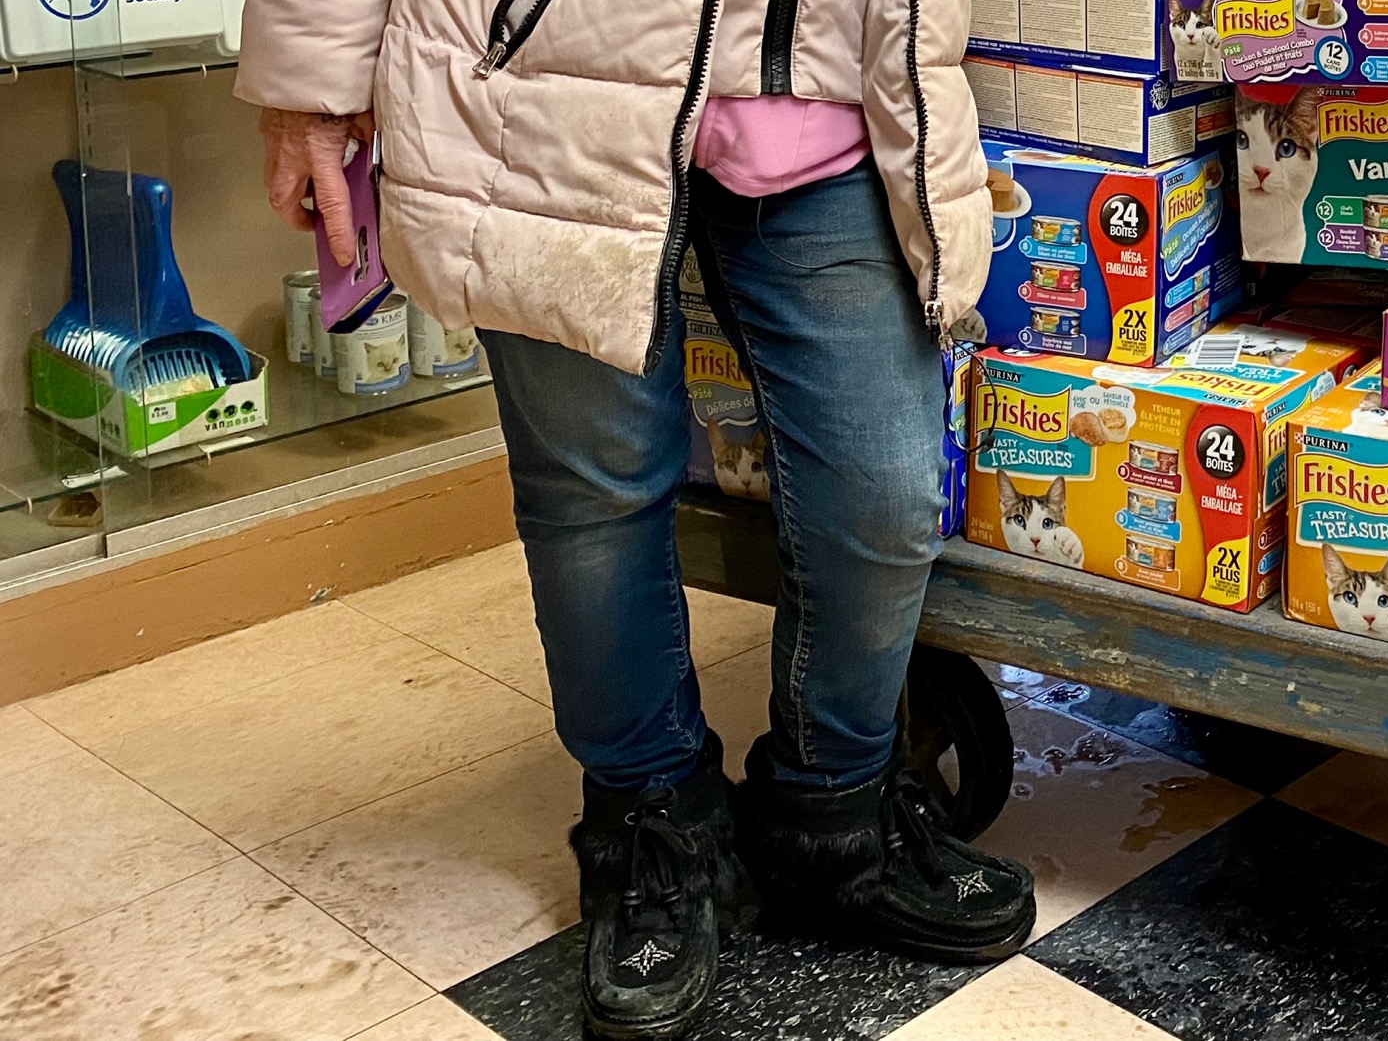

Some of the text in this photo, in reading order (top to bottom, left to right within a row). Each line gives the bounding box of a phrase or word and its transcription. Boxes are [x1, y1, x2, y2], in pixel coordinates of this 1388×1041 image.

[1222, 9, 1289, 31] Friskies
[1231, 39, 1314, 65] Chicken & Seafood Combo
[1326, 43, 1342, 59] 12
[1168, 186, 1202, 222] Friskies
[1110, 203, 1138, 227] 24
[1106, 263, 1147, 277] EMBALLAGE
[1124, 310, 1147, 329] 2X
[1119, 326, 1147, 342] PLUS
[706, 398, 741, 416] Délices
[982, 393, 1062, 432] Friskies
[1206, 434, 1235, 459] 24
[1304, 436, 1347, 451] PURINA
[988, 448, 1074, 467] TREASURES
[1201, 495, 1242, 515] EMBALLAGE
[1218, 547, 1240, 569] 2X
[1212, 566, 1240, 583] PLUS
